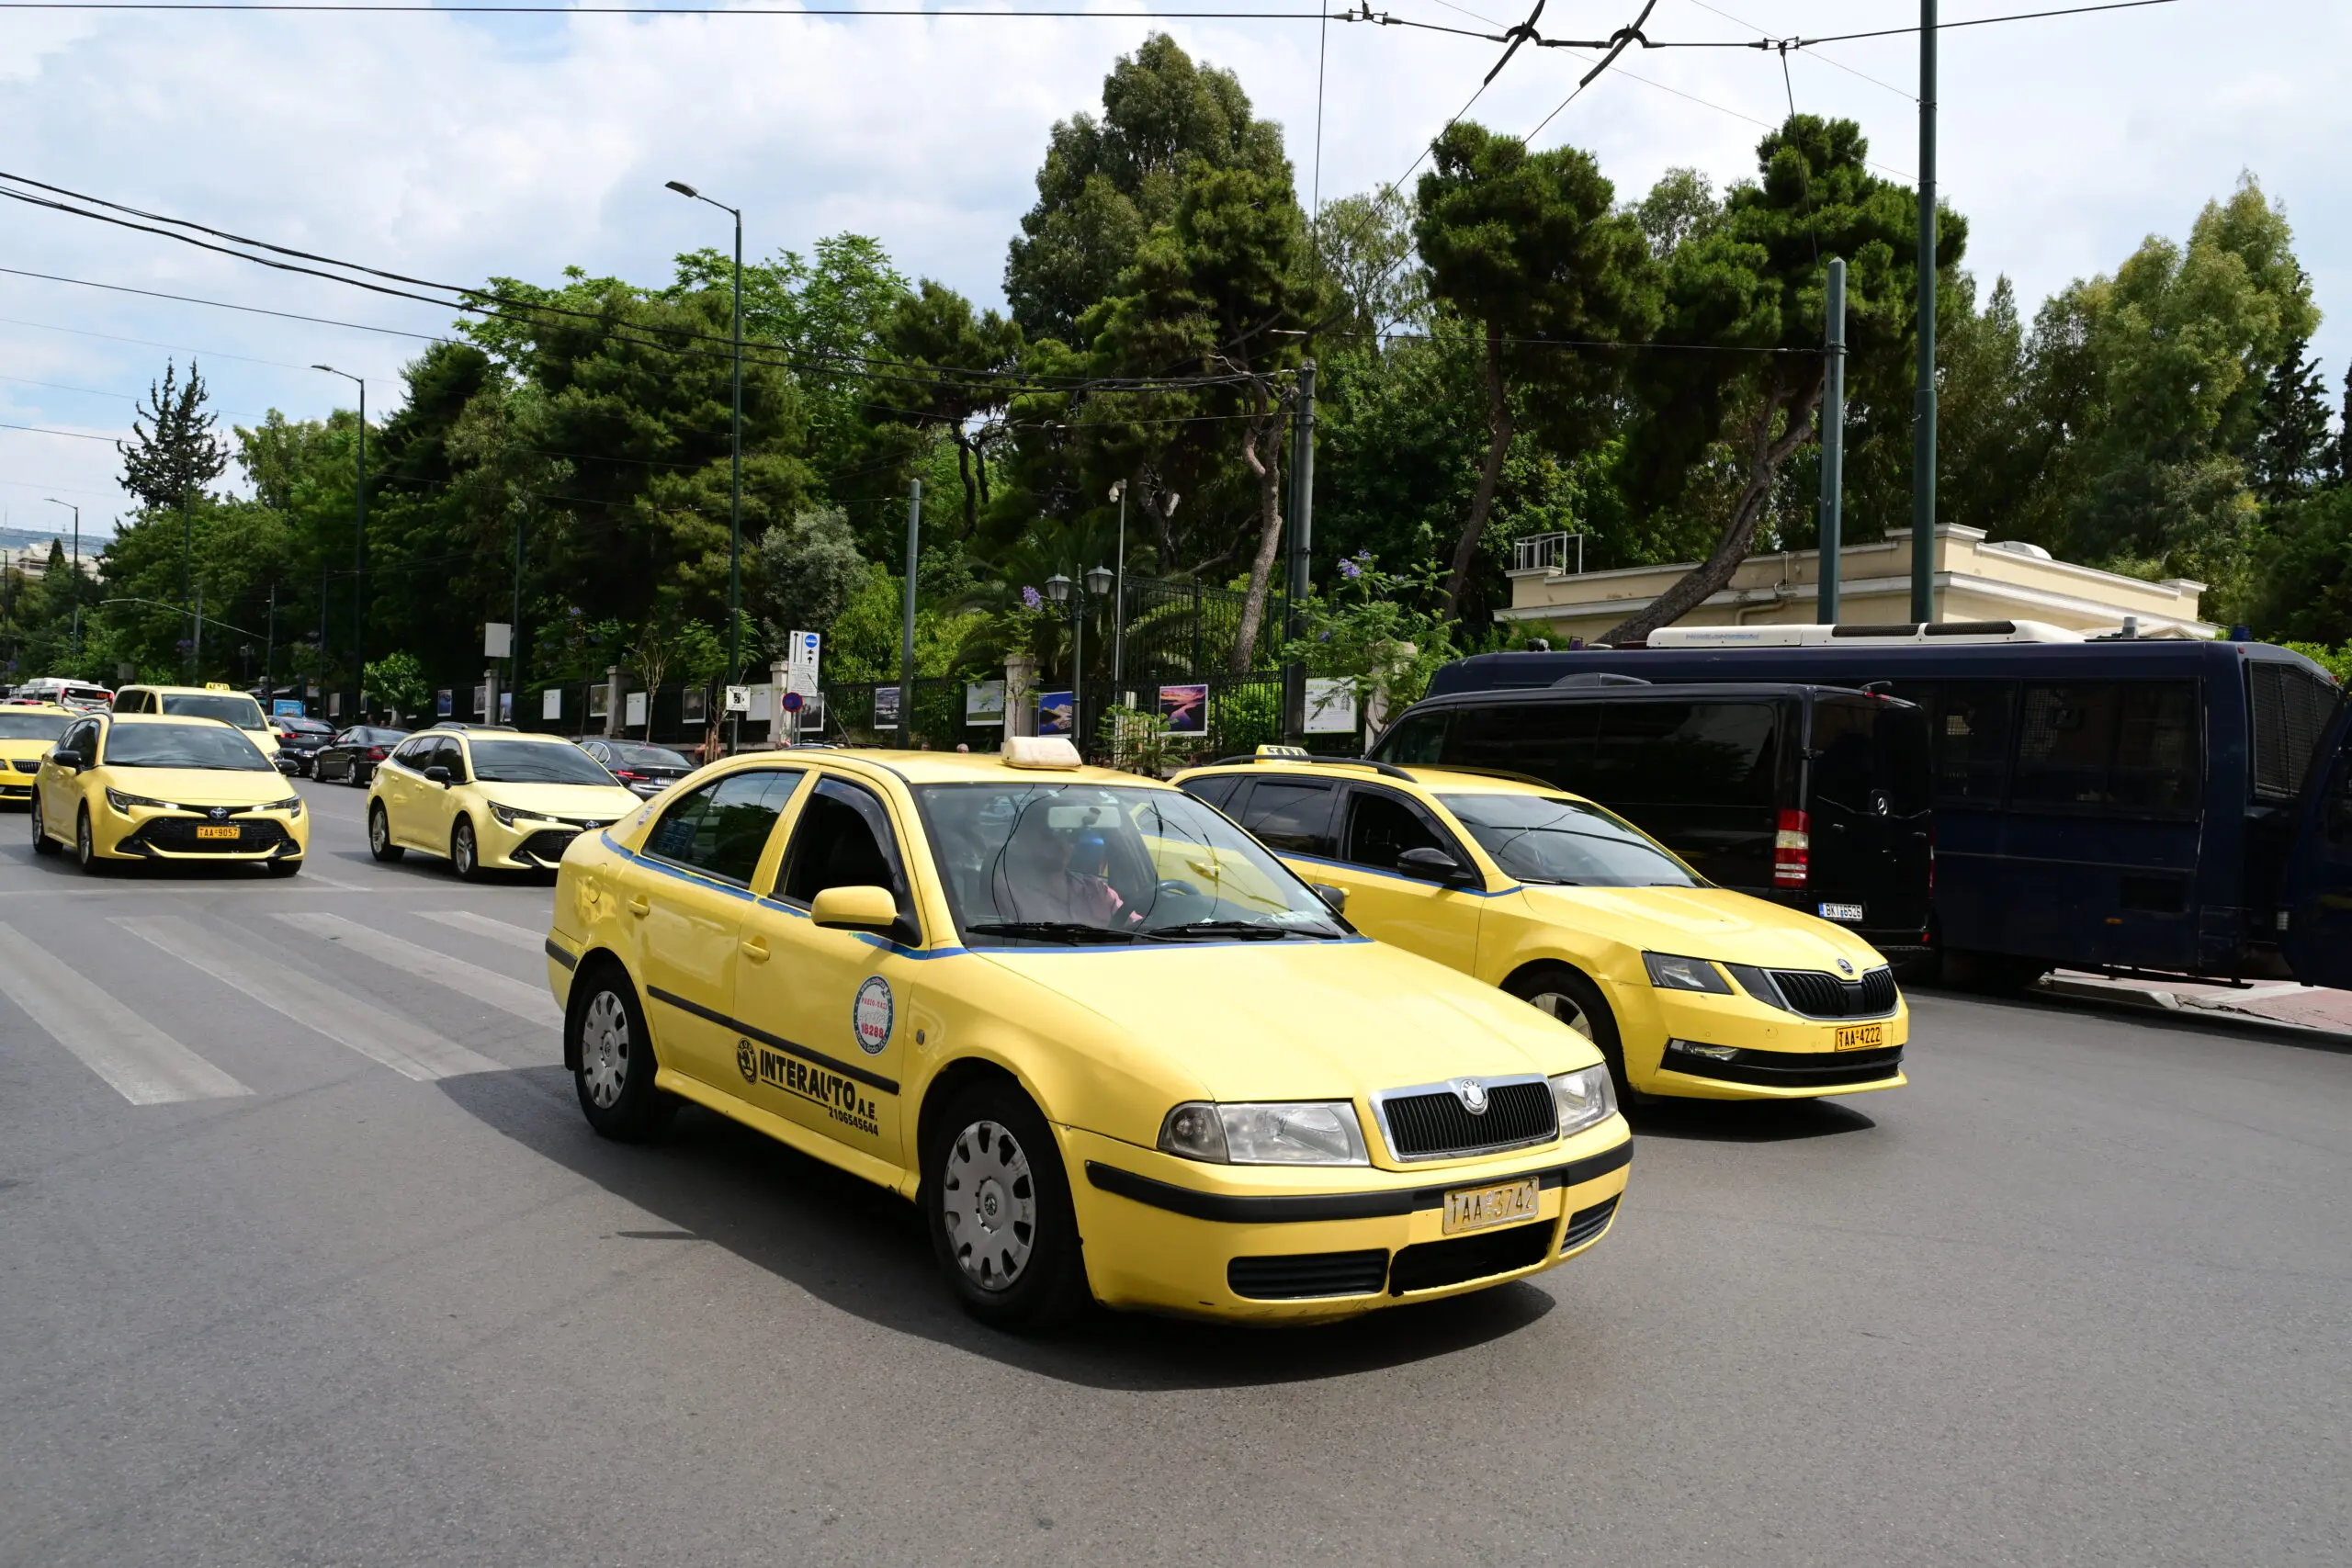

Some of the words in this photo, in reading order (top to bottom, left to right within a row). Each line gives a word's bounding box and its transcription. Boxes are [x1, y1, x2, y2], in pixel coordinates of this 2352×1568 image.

[861, 1022, 885, 1039] 18288
[1838, 1026, 1881, 1047] TAA-4222
[760, 1048, 855, 1111] INTERAUTO
[828, 1106, 879, 1137] 2106545644
